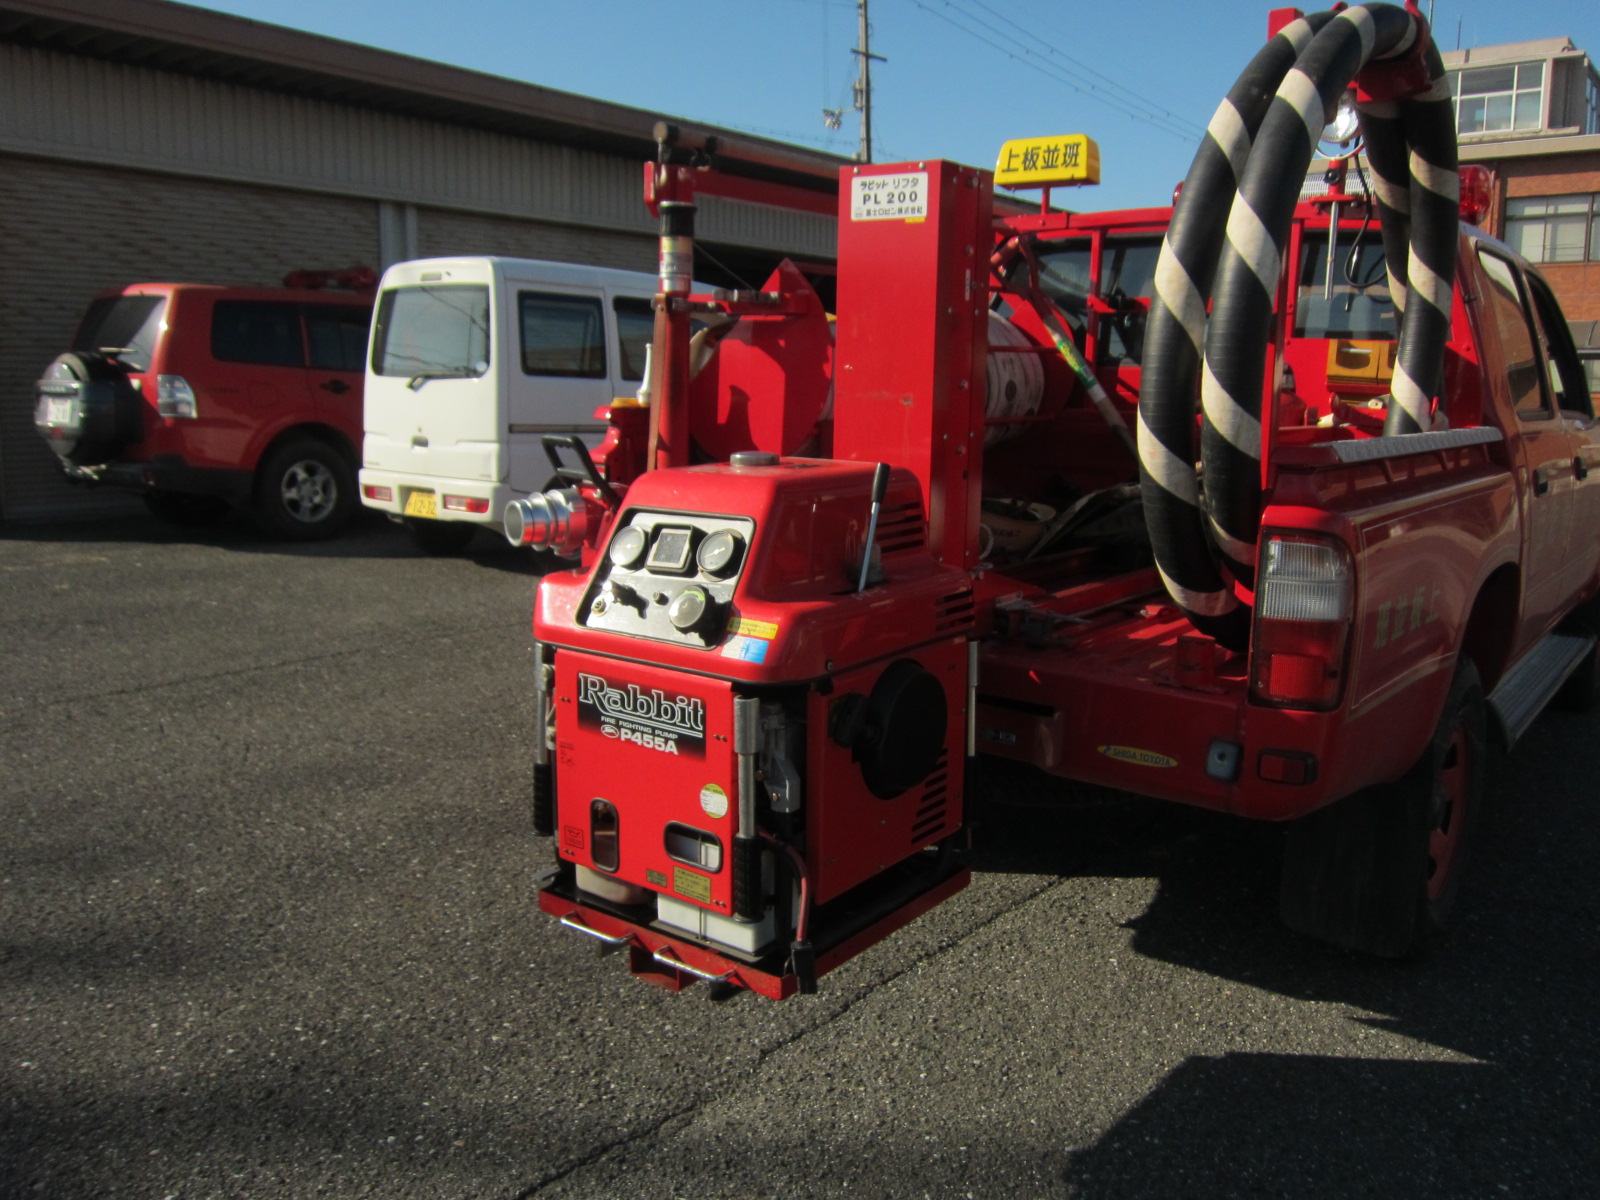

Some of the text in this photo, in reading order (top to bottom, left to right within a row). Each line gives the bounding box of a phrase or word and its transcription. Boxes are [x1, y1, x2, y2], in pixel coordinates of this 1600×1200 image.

[1001, 142, 1081, 173] 上板並班
[860, 176, 919, 191] ラビット リフタ
[579, 673, 703, 737] Rabbit
[600, 715, 678, 739] FIRE FIGHTING PUMP
[620, 727, 679, 756] P455A
